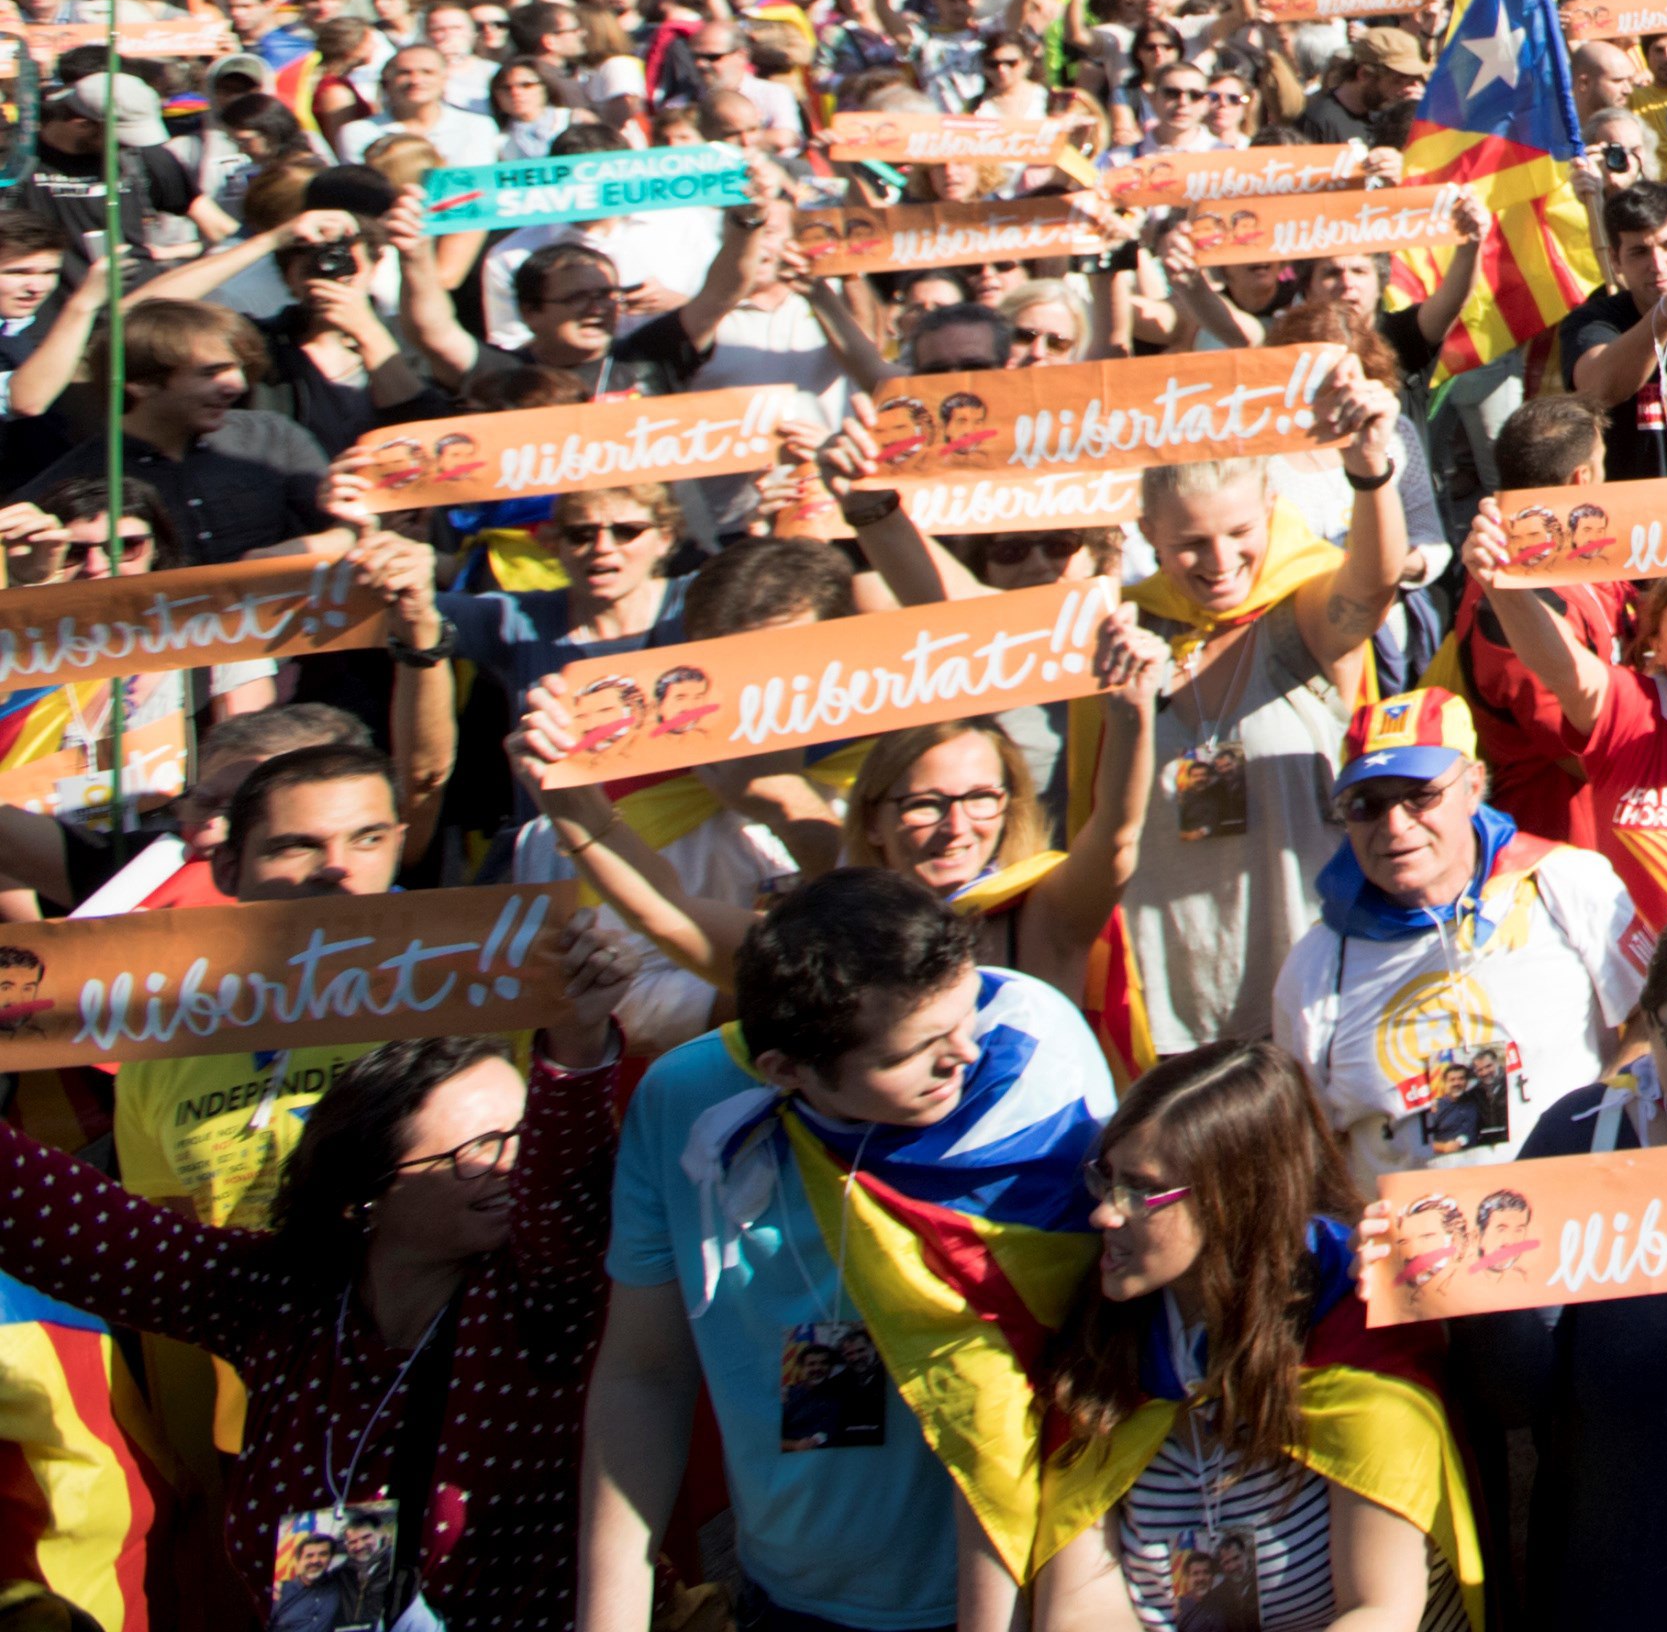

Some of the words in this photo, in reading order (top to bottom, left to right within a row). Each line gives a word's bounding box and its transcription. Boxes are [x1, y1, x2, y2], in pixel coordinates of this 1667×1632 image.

[496, 159, 571, 187] HELP
[497, 185, 599, 217] SAVE
[1184, 146, 1362, 200] llibertat!!
[1270, 190, 1459, 249] llibertat!!
[497, 393, 775, 490] llibertat!!
[1009, 352, 1330, 468] llibertat!!
[731, 587, 1103, 746] llibertat!!
[74, 896, 550, 1049] llibertat!!
